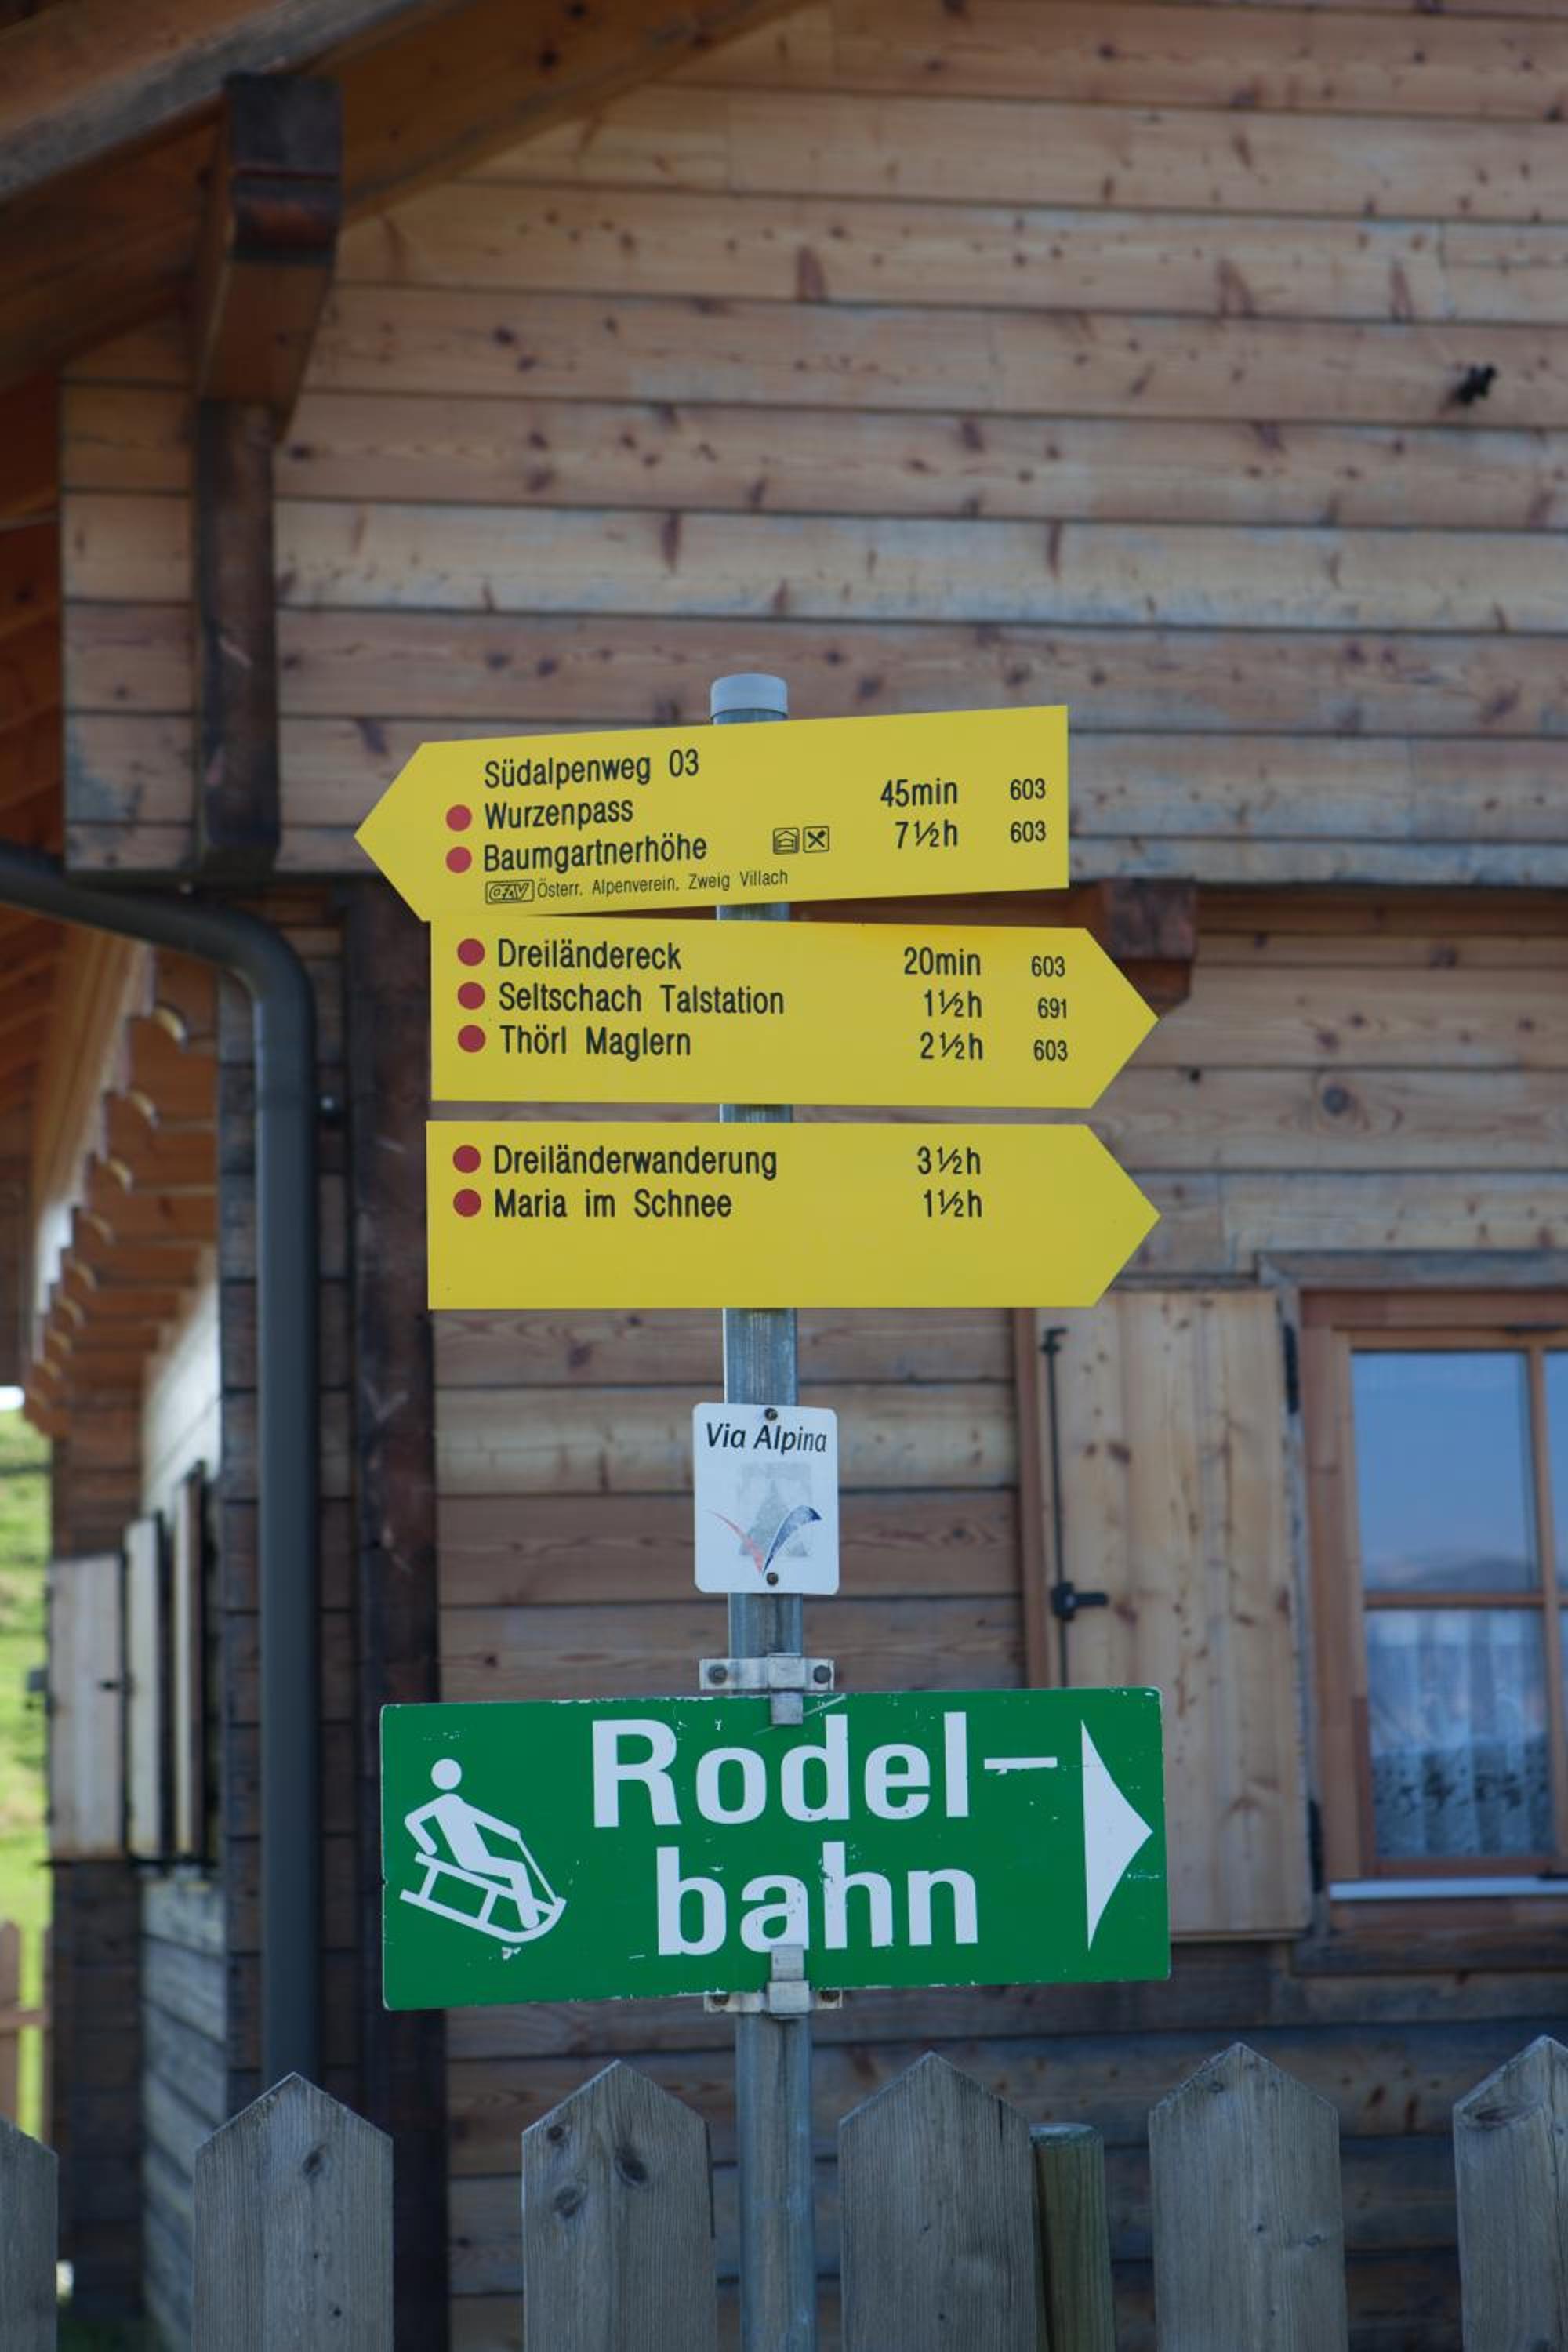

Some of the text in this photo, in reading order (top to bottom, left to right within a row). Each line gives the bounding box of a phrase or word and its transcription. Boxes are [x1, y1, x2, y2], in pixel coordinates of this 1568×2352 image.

[484, 748, 699, 791] Südalpenweg 03
[484, 777, 1047, 831] Wurzenpass 45min 603
[484, 833, 707, 874] Baumgartnerhöhe
[1010, 820, 1047, 844] 603
[536, 877, 583, 898] Österr.
[688, 873, 731, 891] Zweig
[739, 869, 788, 887] Villach
[498, 938, 1065, 978] Dreiländereck 20min 603
[499, 981, 642, 1013] Seltschach
[659, 984, 784, 1014] Talstation
[1037, 997, 1067, 1019] 691
[499, 1024, 567, 1054] Thörl
[586, 1025, 691, 1062] Maglern
[1033, 1039, 1069, 1062] 603
[494, 1144, 777, 1181] Dreiländerwanderung
[495, 1188, 568, 1218] Maria
[585, 1189, 615, 1218] im
[633, 1188, 732, 1218] Schnee
[706, 1421, 827, 1456] Via Alpina
[591, 1711, 1058, 1829] Rodel-
[655, 1840, 979, 1957] bahn
